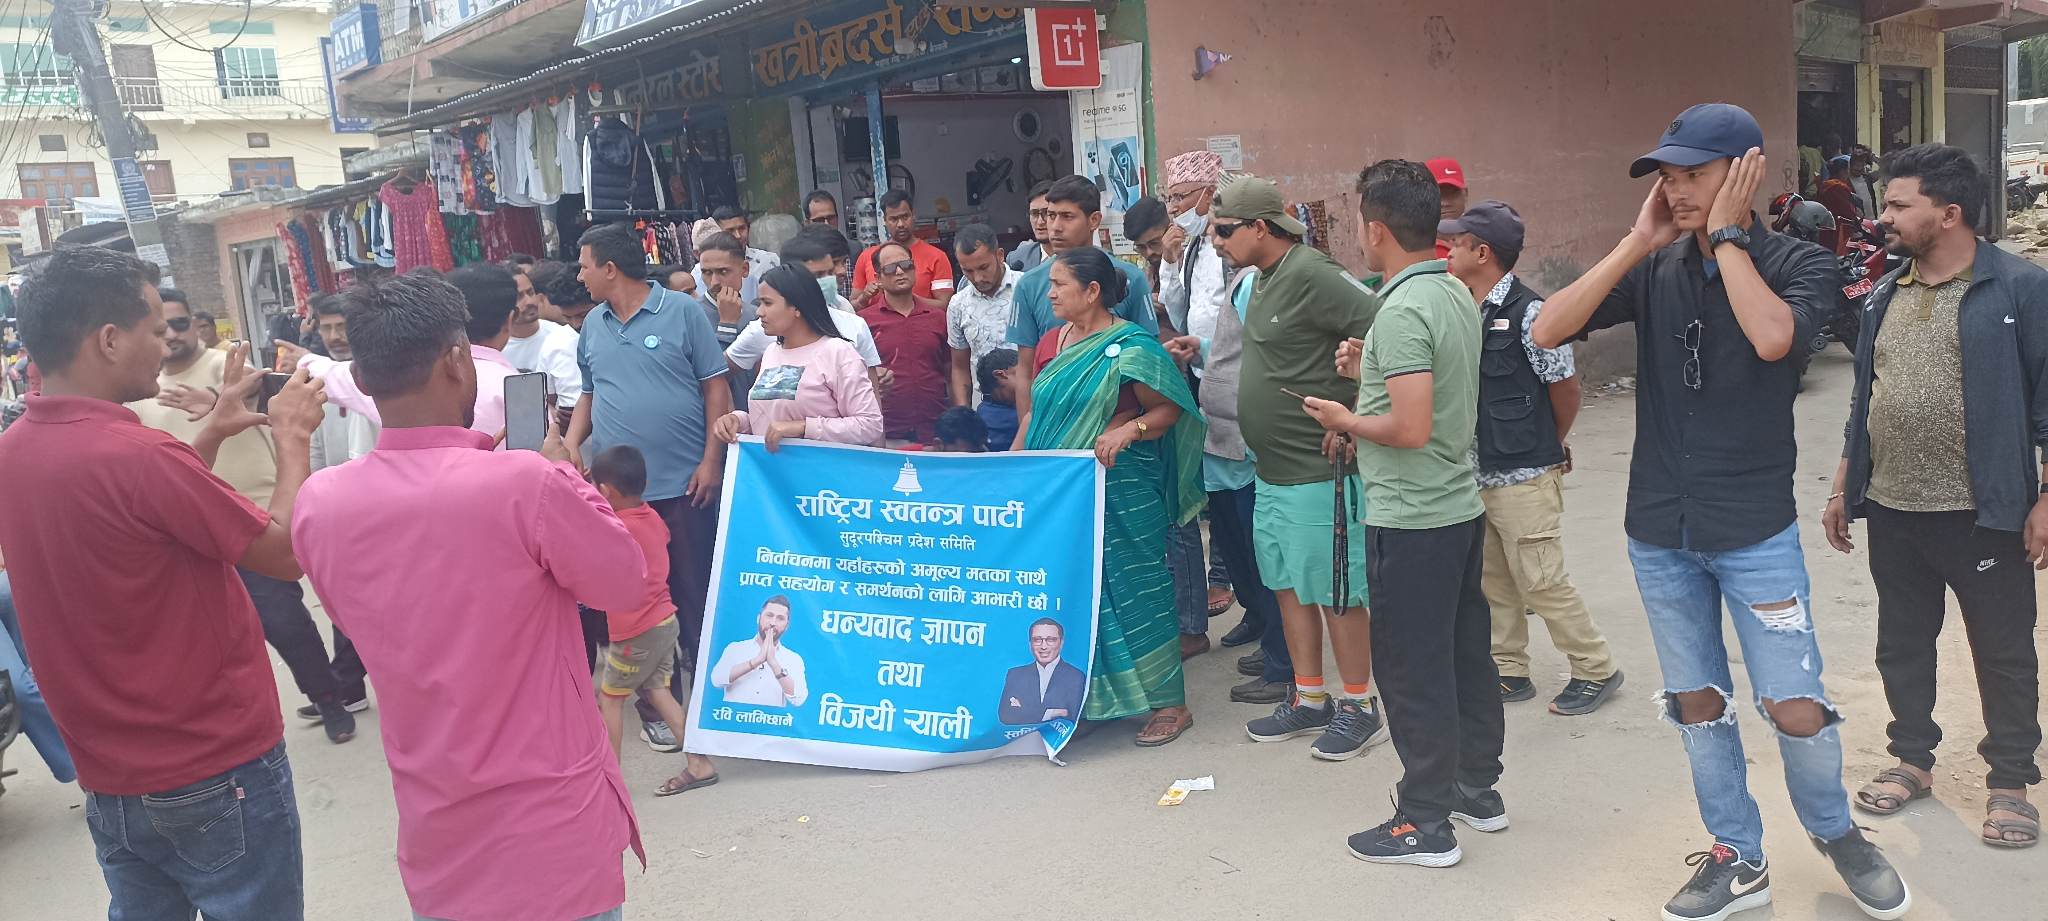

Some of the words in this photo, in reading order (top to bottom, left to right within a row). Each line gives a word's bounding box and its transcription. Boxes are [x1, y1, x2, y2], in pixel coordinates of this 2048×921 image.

[334, 20, 364, 62] ATM
[796, 489, 873, 524] राष्ट्रिय
[880, 499, 965, 526] स्वतन्त्र
[973, 500, 1025, 529] पार्टी
[840, 529, 903, 548] सुदूरपश्चिम
[907, 533, 936, 549] प्रदेश
[939, 533, 977, 551] समिति
[756, 546, 832, 570] निर्वाचनमा
[910, 563, 962, 582] अमूल्य
[966, 566, 1012, 583] मतका
[1015, 567, 1048, 586] साथै
[739, 572, 774, 587] प्राप्त
[778, 574, 836, 593] सहयोग
[840, 581, 851, 595] र
[854, 581, 925, 601] समर्थनको
[928, 584, 967, 604] लागि
[970, 590, 1024, 609] आभारी
[820, 609, 915, 643] धन्यवाद
[920, 617, 987, 647] ज्ञापन
[877, 660, 925, 688] तथा
[712, 706, 733, 721] रवि
[735, 709, 794, 727] लामिछाने
[818, 692, 897, 732] विजयी
